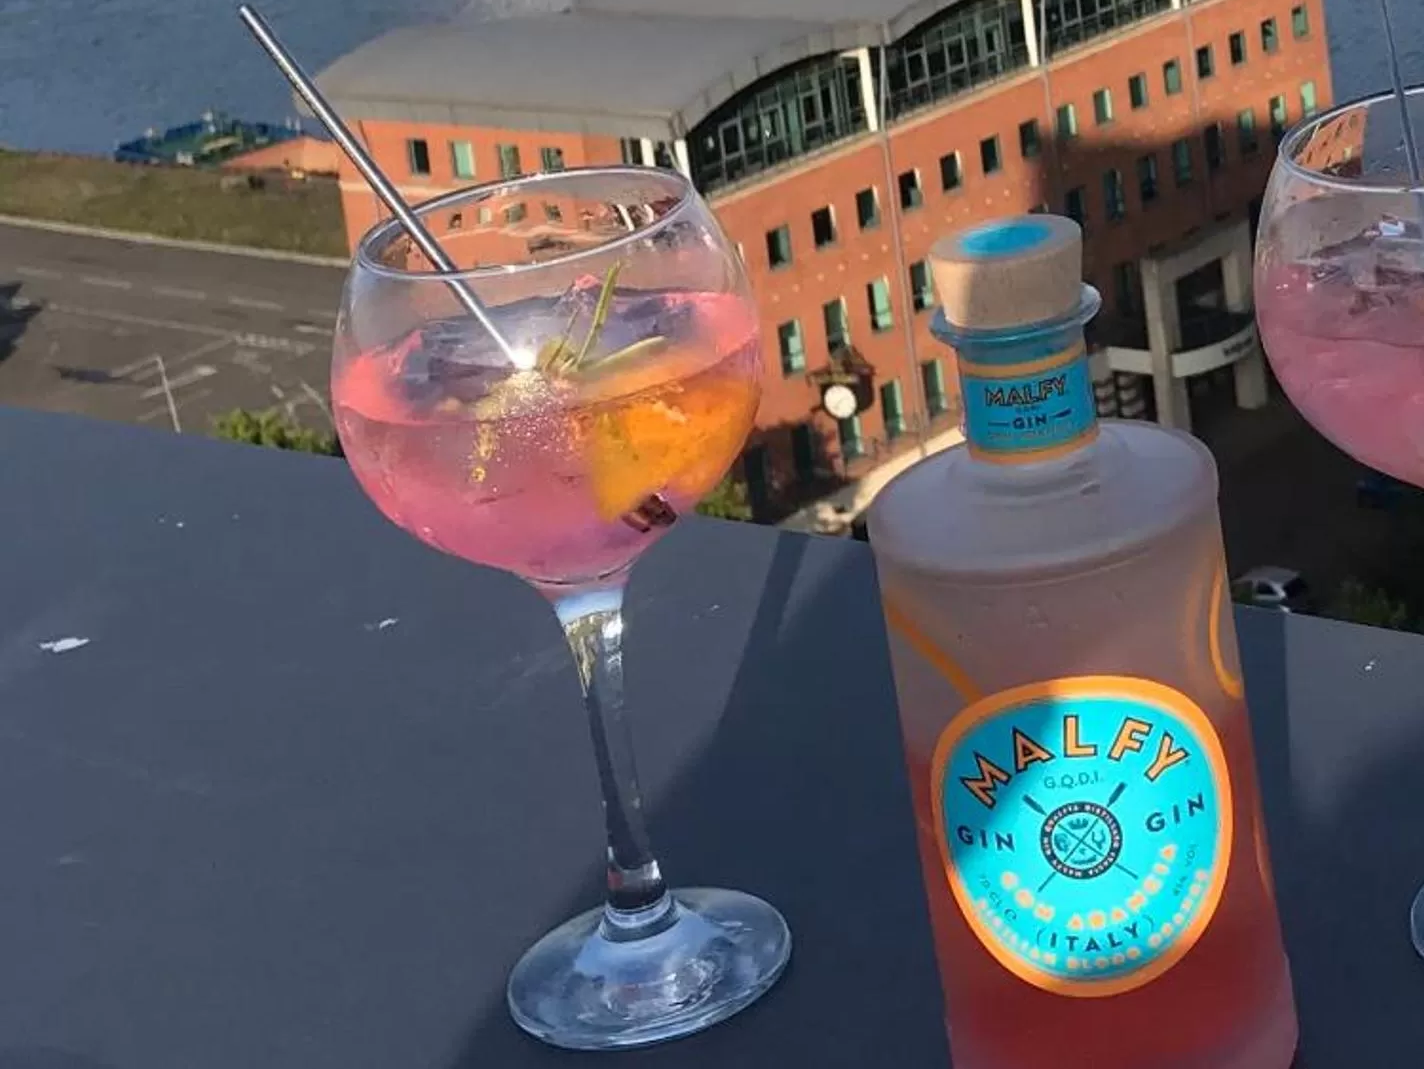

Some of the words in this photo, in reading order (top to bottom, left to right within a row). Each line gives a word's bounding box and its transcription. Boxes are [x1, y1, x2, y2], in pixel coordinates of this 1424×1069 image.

[985, 373, 1068, 407] MALFY
[1013, 413, 1047, 430] GIN
[959, 715, 1190, 810] MALFY
[1145, 792, 1205, 833] GIN
[957, 825, 1015, 853] GIN
